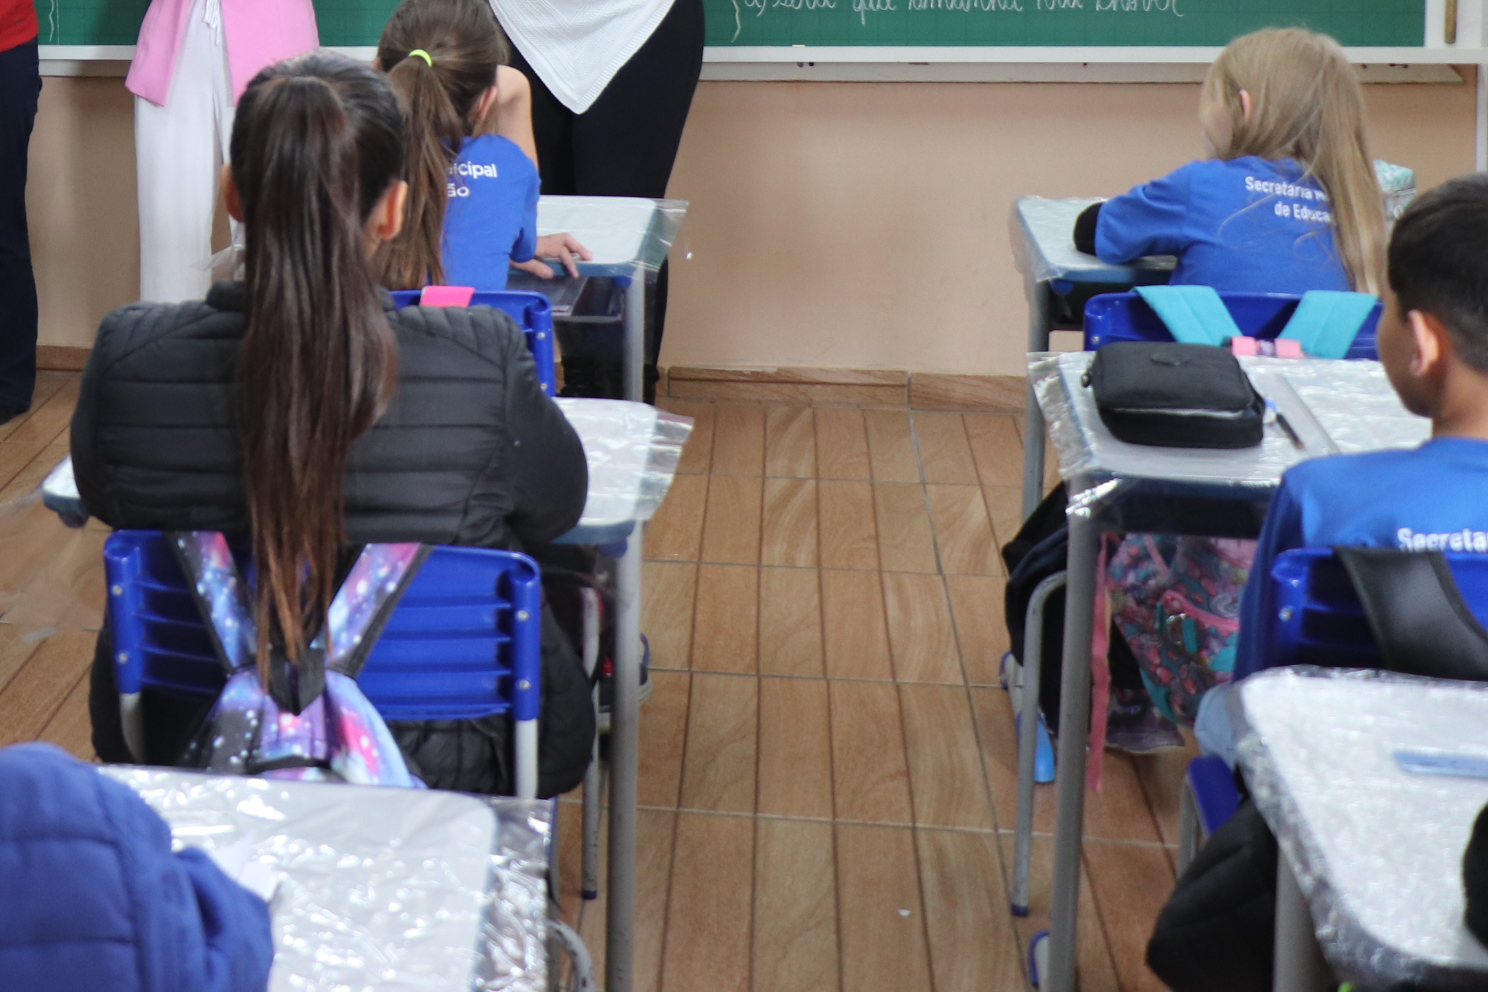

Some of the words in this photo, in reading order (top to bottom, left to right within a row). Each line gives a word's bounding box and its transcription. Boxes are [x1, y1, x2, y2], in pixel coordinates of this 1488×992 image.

[1245, 176, 1311, 200] Secretaria
[1274, 201, 1290, 217] de
[1293, 204, 1331, 223] Educa
[1397, 527, 1488, 553] Secreta
